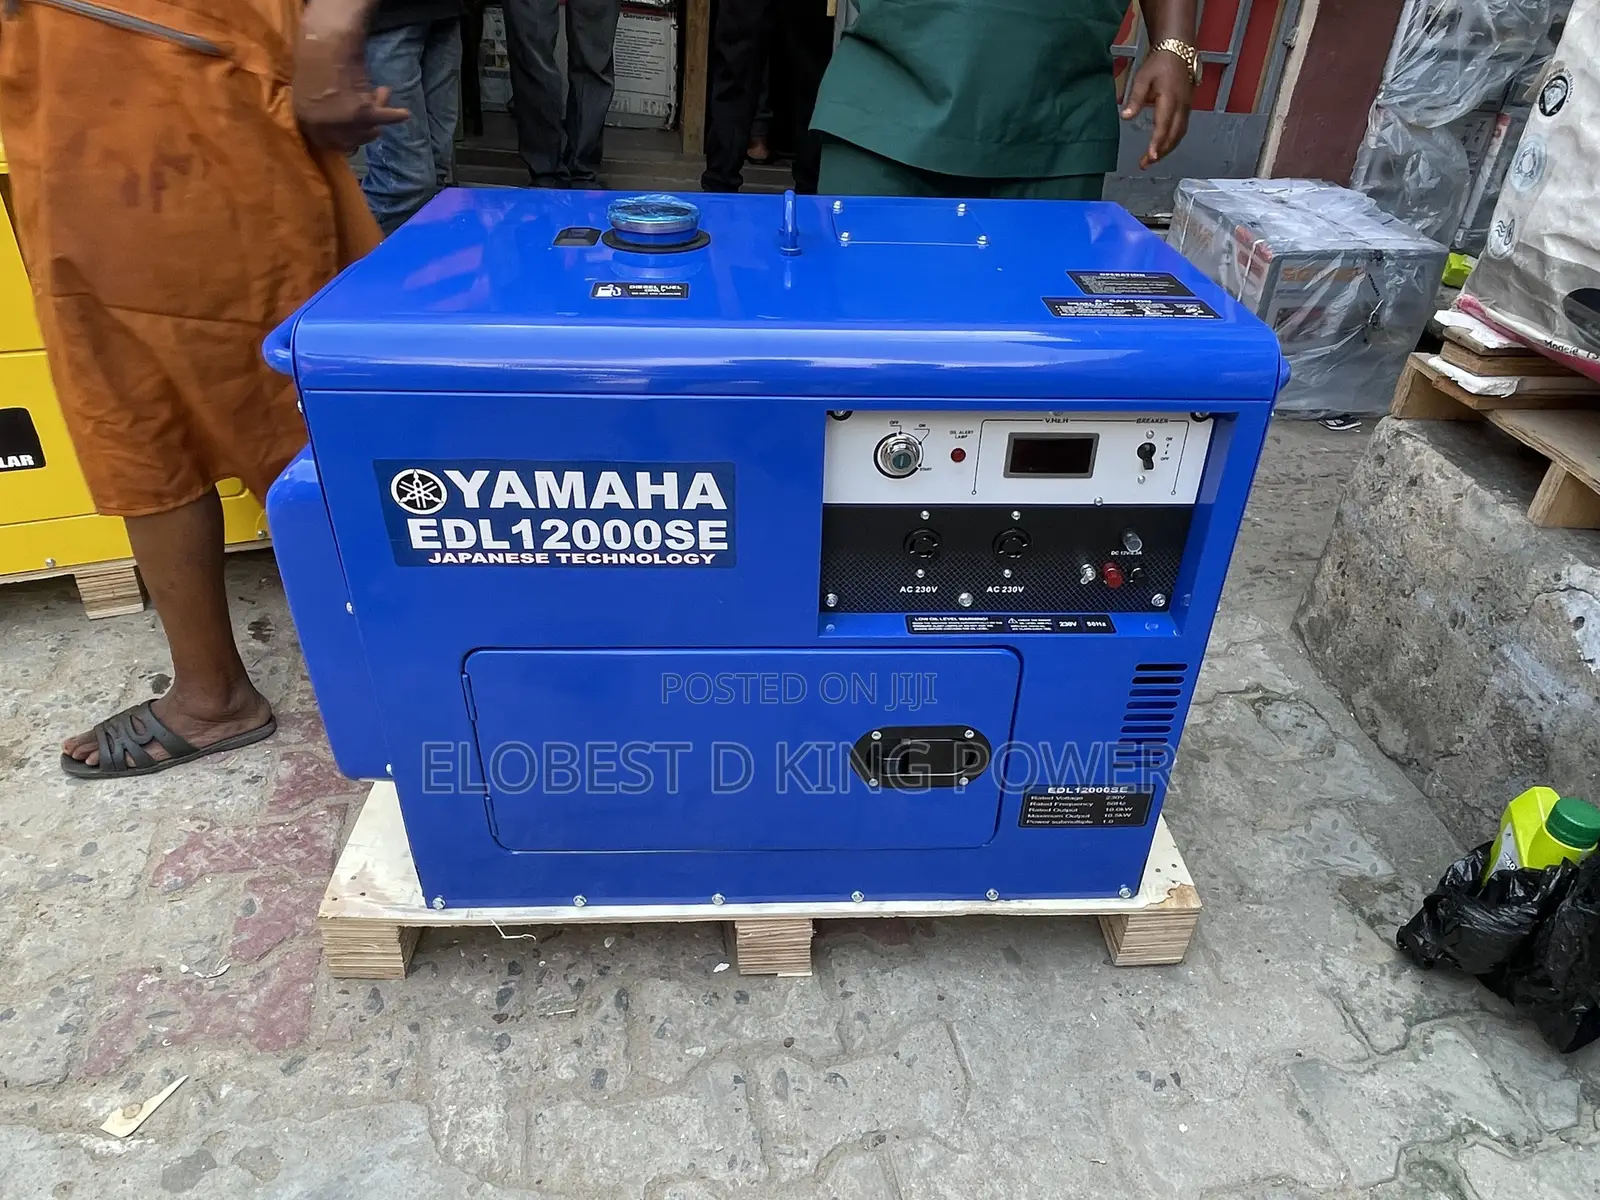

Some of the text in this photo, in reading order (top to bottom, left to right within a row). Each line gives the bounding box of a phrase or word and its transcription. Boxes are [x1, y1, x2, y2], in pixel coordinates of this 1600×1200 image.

[622, 12, 663, 22] Generator
[443, 469, 728, 510] YAMAHA
[407, 518, 729, 550] EDL12000SE
[427, 552, 716, 565] JAPANESE TECHNOLOGY
[899, 585, 938, 593] AC 230V
[986, 585, 1025, 593] AC 230V
[1047, 786, 1129, 794] EDL12000SE
